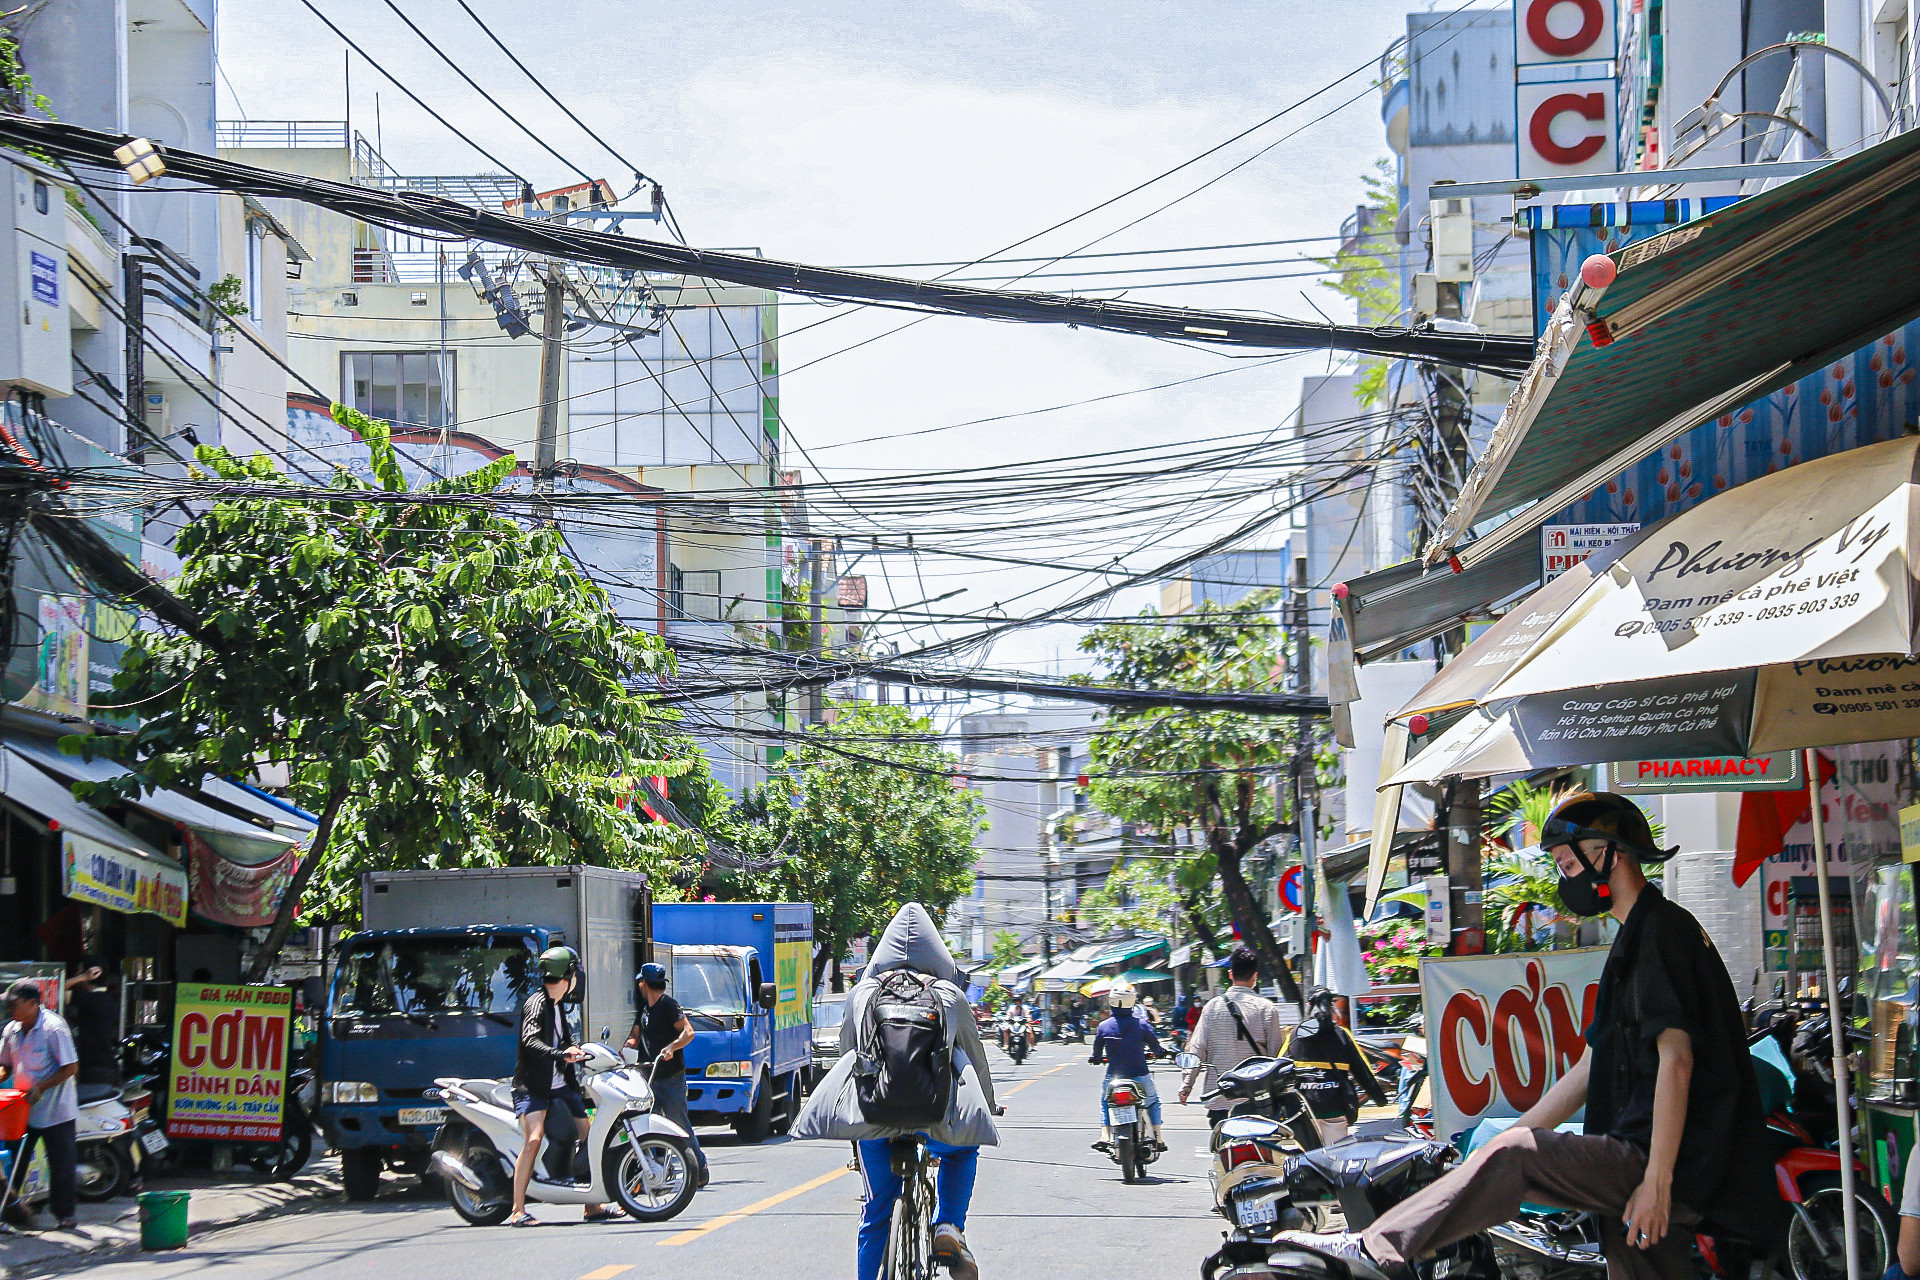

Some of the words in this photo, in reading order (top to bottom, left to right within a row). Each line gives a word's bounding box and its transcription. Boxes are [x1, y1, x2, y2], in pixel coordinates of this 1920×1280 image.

[1570, 526, 1582, 536] MÁI
[1607, 525, 1619, 536] NỘI
[1588, 537, 1602, 547] KÉO
[1646, 537, 1824, 582] Phương
[1835, 515, 1891, 564] Vy
[1642, 597, 1693, 613] Đam
[1697, 590, 1734, 607] mê
[1738, 585, 1762, 601] cà
[1764, 577, 1813, 600] phê
[1815, 568, 1860, 589] Việt
[1642, 618, 1681, 635] 0905
[1682, 614, 1711, 631] 501
[1713, 610, 1744, 627] 339
[1756, 603, 1796, 621] 0935
[1797, 598, 1828, 615] 903
[1830, 592, 1861, 611] 339
[1562, 700, 1603, 712] Cung
[1605, 697, 1636, 711] Cấp
[1656, 694, 1677, 707] Cà
[1681, 690, 1708, 704] Phê
[1711, 684, 1738, 700] Hạt
[1815, 687, 1863, 697] Đam
[1865, 683, 1897, 695] mê
[1577, 715, 1598, 726] Trợ
[1638, 710, 1672, 723] Quán
[1675, 706, 1695, 718] Cà
[1697, 704, 1720, 717] Phê
[1839, 702, 1873, 713] 0905
[1874, 700, 1899, 711] 501
[1537, 729, 1561, 741] Bán
[1561, 728, 1579, 740] Và
[1577, 727, 1601, 740] Cho
[1602, 724, 1630, 738] Thuê
[1628, 722, 1653, 738] Máy
[1654, 721, 1677, 734] Pha
[1677, 719, 1697, 732] Cà
[1696, 716, 1719, 731] Phê
[1638, 757, 1772, 779] PHARMACY
[200, 987, 221, 1001] GIA
[178, 1008, 286, 1071] CƠM
[175, 1070, 230, 1096] BÌNH
[234, 1072, 282, 1098] DÂN
